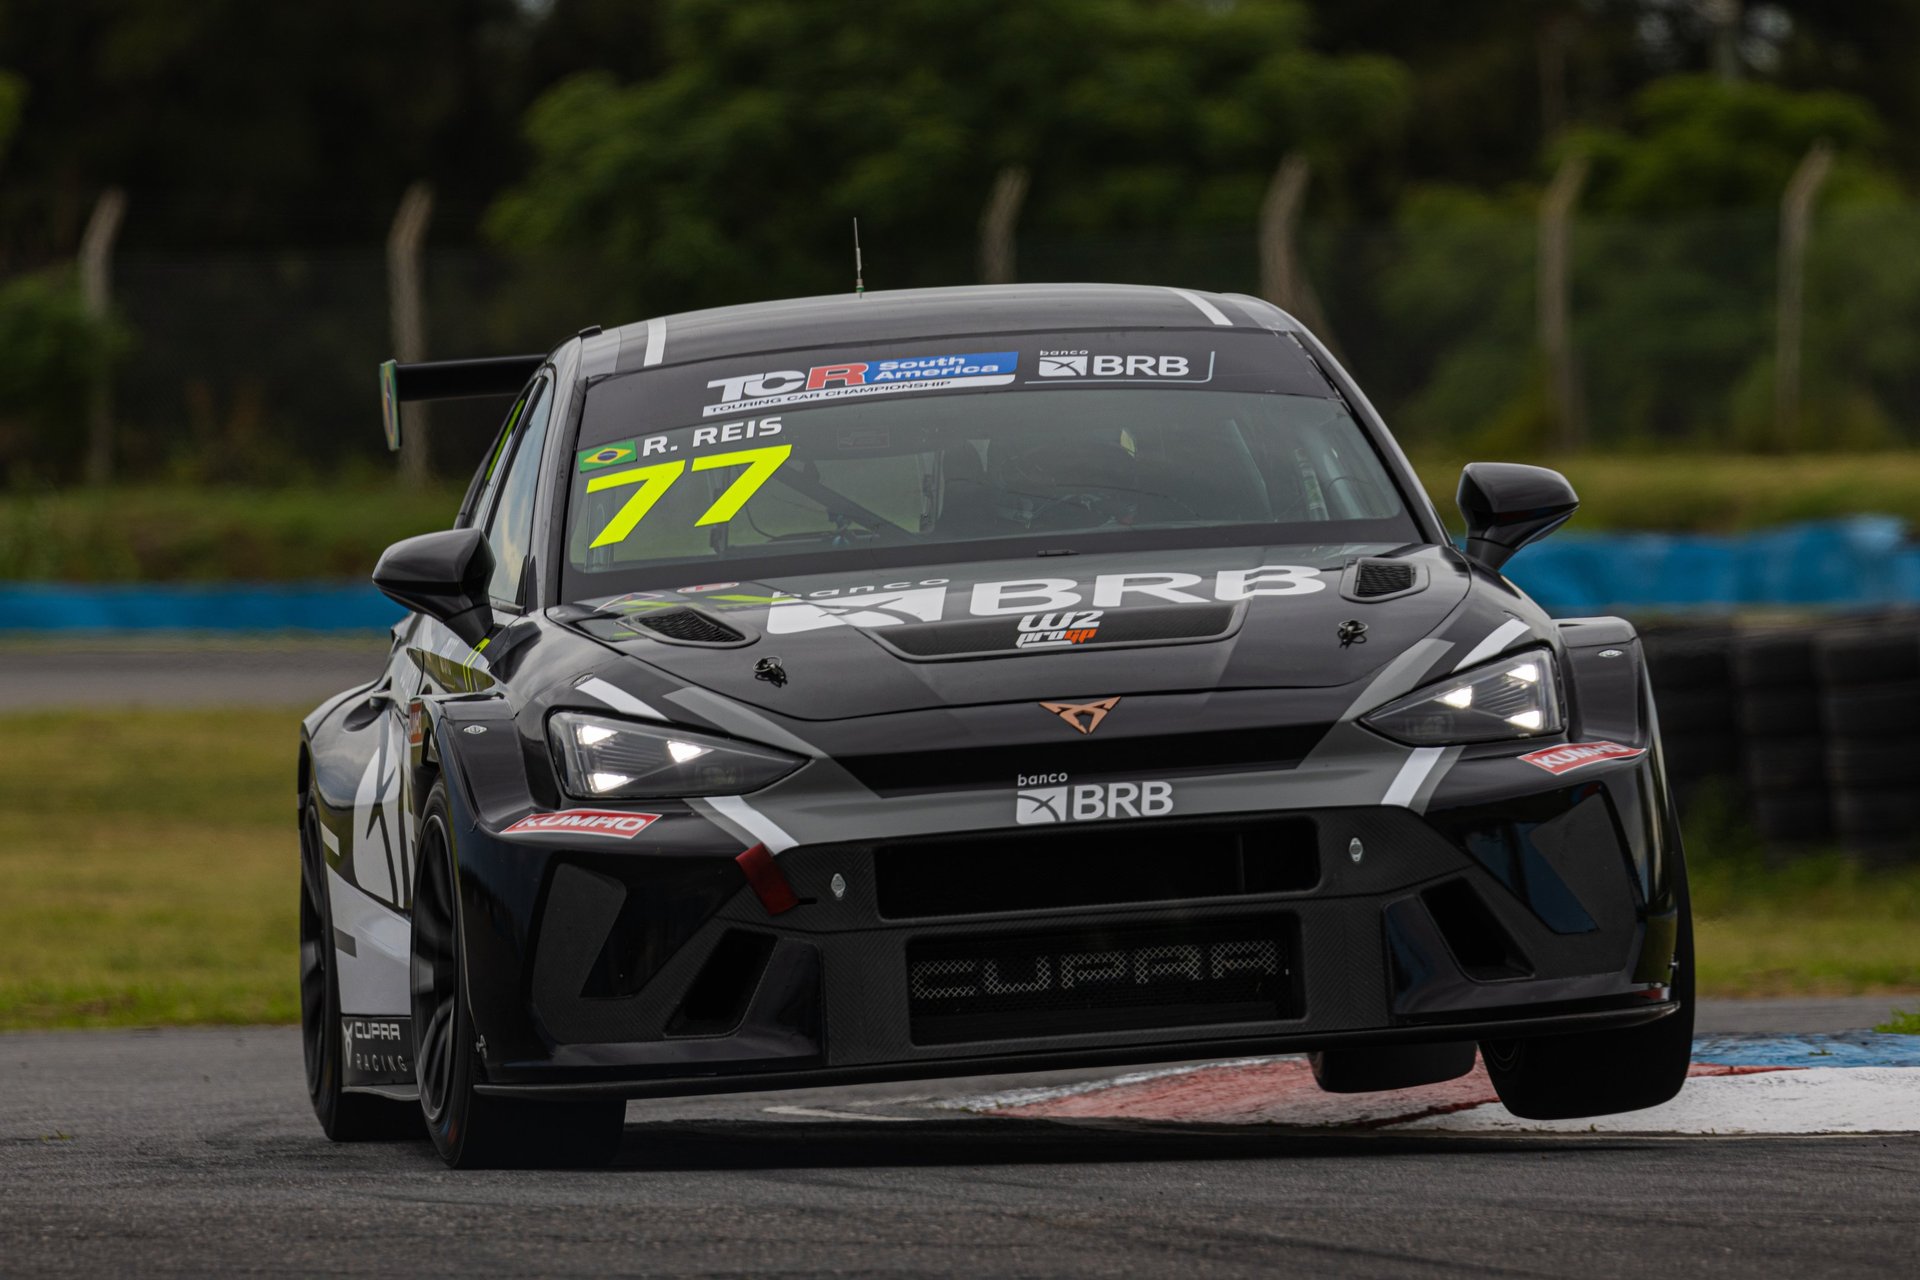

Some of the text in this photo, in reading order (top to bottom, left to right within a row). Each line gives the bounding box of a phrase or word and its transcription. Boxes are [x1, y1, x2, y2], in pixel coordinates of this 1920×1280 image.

[878, 356, 966, 371] South
[1039, 349, 1089, 357] banco
[874, 364, 999, 382] America
[1092, 355, 1190, 376] BRB
[707, 362, 869, 403] TCR
[710, 380, 952, 414] TOURING CAR CHAMPIONSHIP
[642, 416, 783, 457] R. REIS
[586, 444, 793, 549] 77
[969, 565, 1327, 616] BRB
[1017, 610, 1104, 632] W2
[1017, 771, 1069, 787] banco
[1072, 780, 1174, 821] BRB
[515, 815, 647, 831] KUMHO
[911, 940, 1281, 999] CUPRA
[354, 1022, 401, 1041] CUPRA
[356, 1053, 408, 1072] RACING
